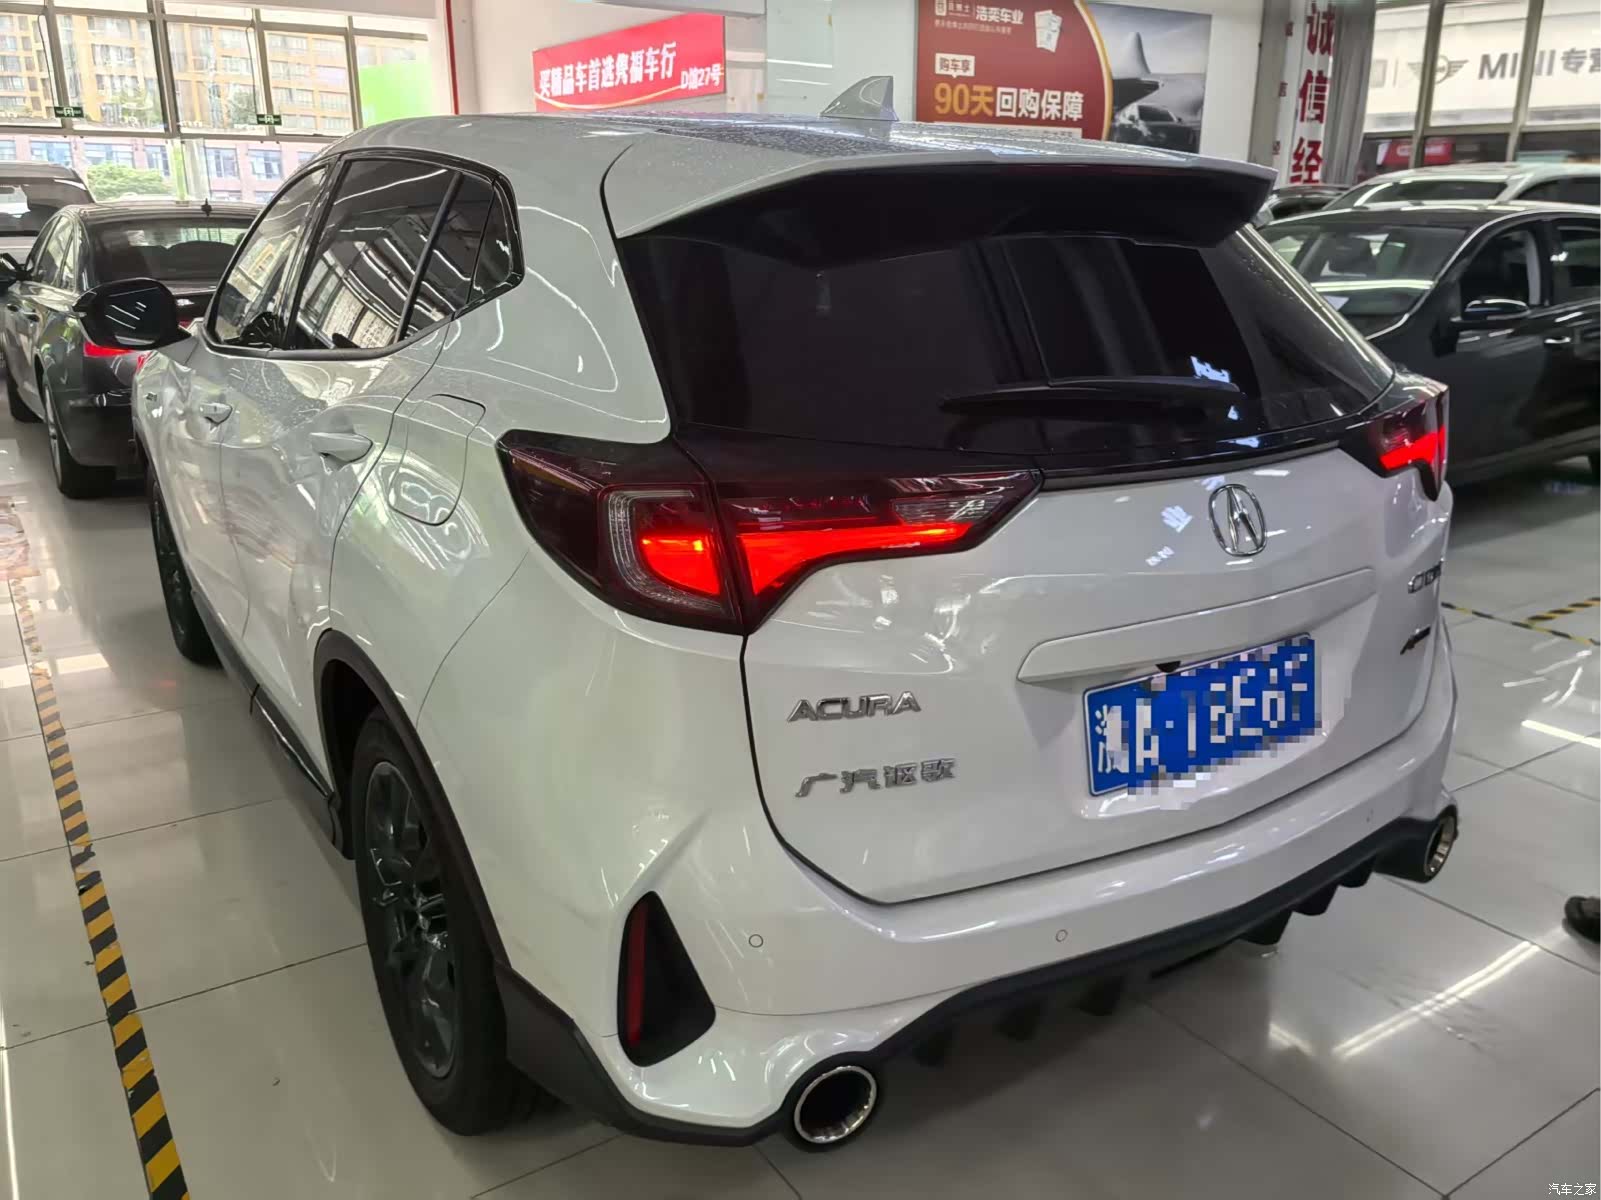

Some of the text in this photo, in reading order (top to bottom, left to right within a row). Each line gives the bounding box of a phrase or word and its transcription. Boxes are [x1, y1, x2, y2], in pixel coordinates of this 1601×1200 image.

[939, 57, 970, 73] 购车享
[934, 83, 1083, 121] 90天回购保障
[1290, 1, 1335, 184] 诚信经
[786, 690, 922, 722] ACURA
[794, 757, 956, 798] 广汽讴歌
